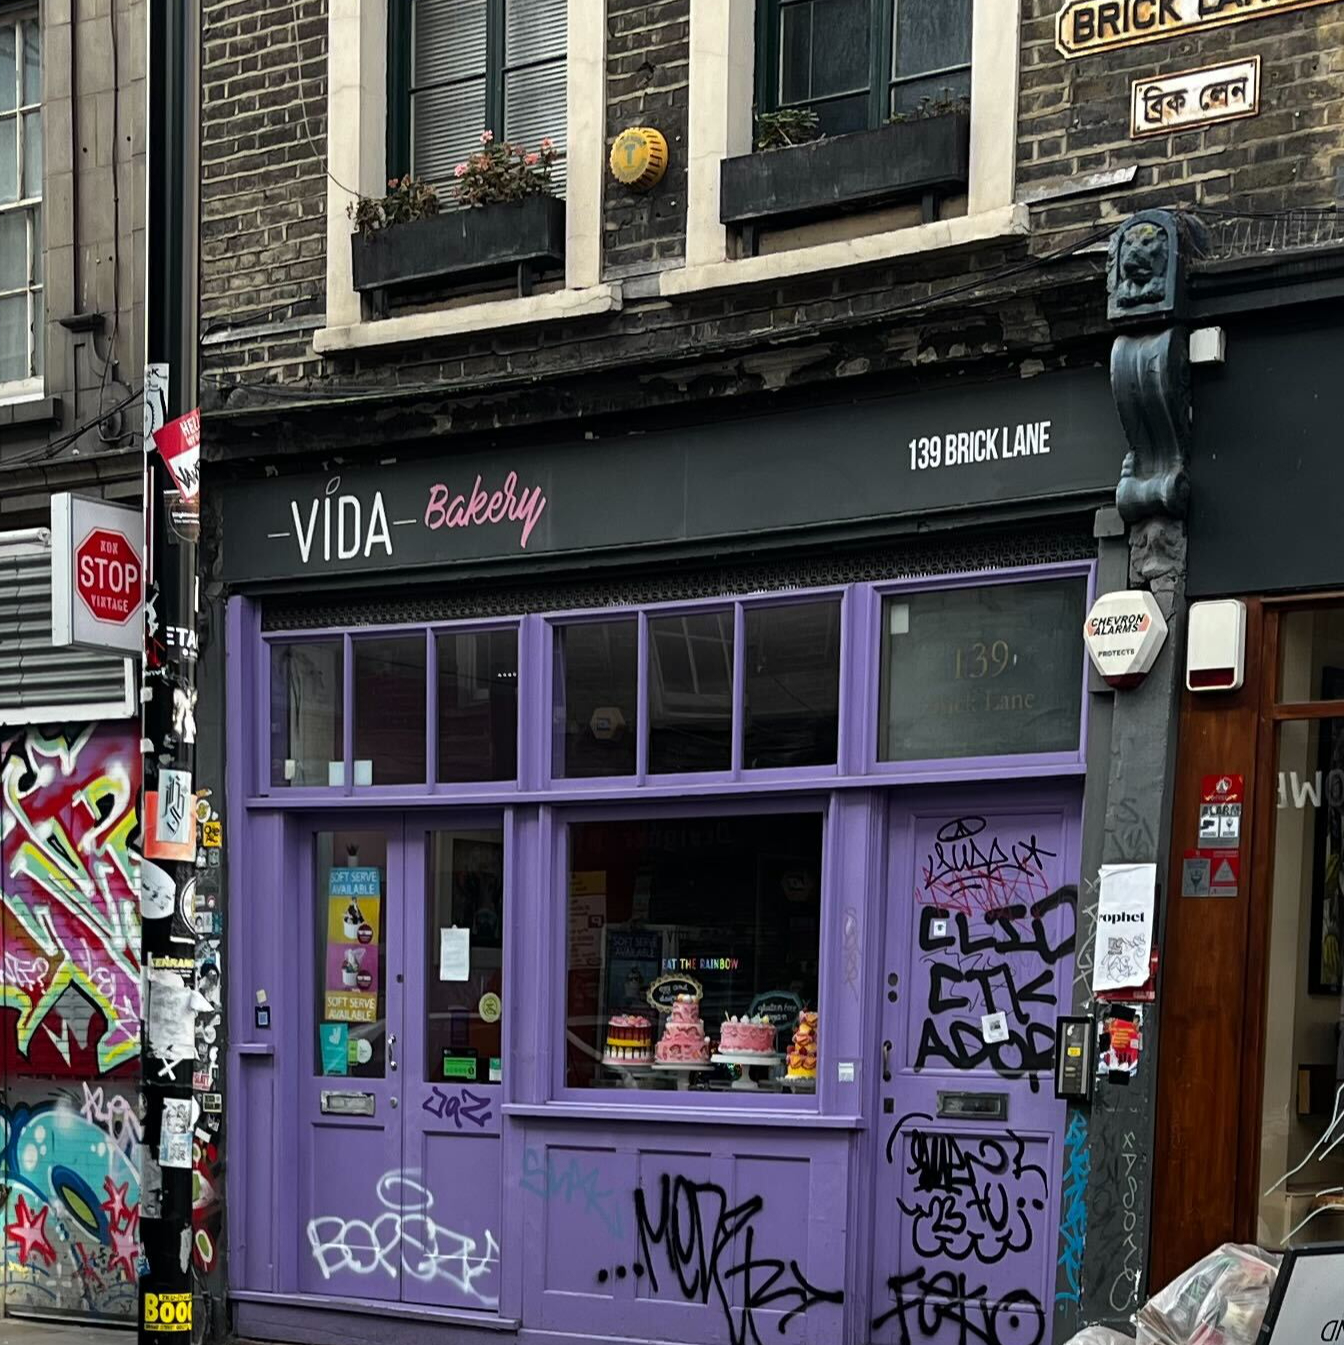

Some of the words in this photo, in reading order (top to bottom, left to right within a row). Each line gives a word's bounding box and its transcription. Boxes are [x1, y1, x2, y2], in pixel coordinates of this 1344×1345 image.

[1073, 0, 1183, 44] BRICK
[907, 437, 943, 472] 139
[945, 429, 1001, 467] BRICK
[1003, 420, 1051, 461] LANE
[424, 471, 547, 549] Bakery
[100, 540, 119, 555] NON
[80, 555, 138, 594] STOP
[91, 594, 129, 613] VINTAGE
[1090, 614, 1145, 628] CHEVRON
[1093, 623, 1140, 636] ALARMS
[955, 640, 1010, 680] 139
[1097, 648, 1135, 658] PROTECTS
[984, 690, 1035, 712] Lane
[330, 871, 349, 883] SOFT
[351, 871, 377, 883] SERVE
[332, 884, 375, 895] AVAILABLE
[662, 958, 678, 971] EAT
[680, 958, 697, 970] THE
[699, 957, 739, 971] RAINBOW
[327, 997, 347, 1008] SOFT
[349, 997, 376, 1010] SERVE
[329, 1009, 373, 1021] AVAILABLE
